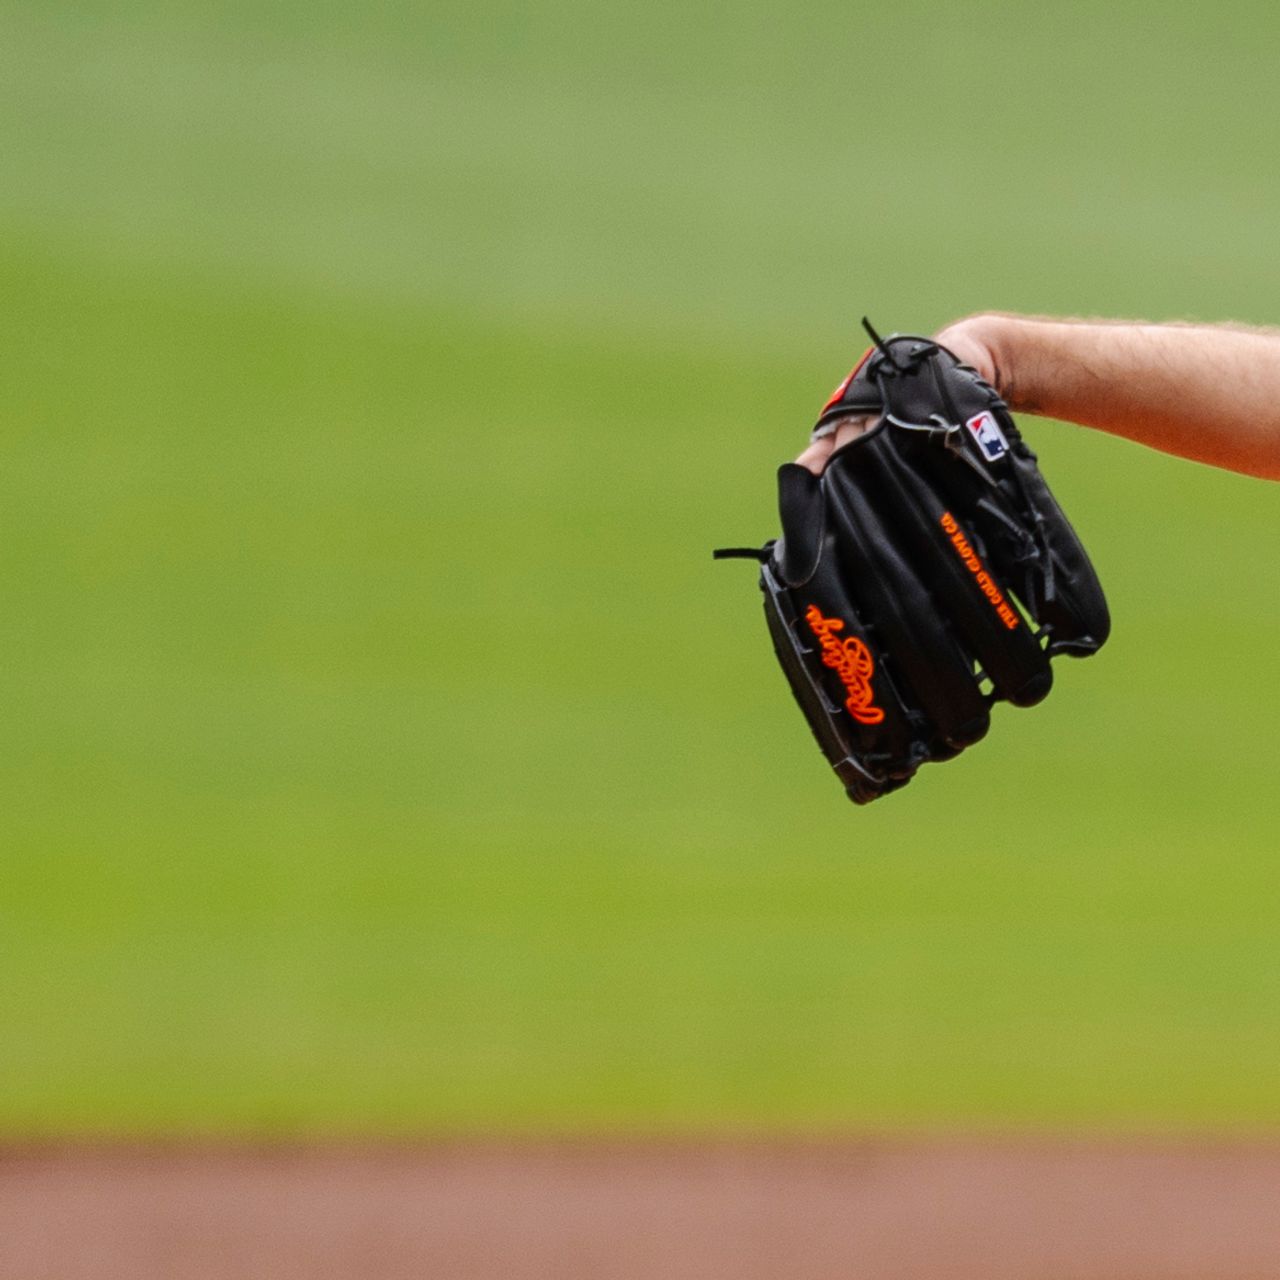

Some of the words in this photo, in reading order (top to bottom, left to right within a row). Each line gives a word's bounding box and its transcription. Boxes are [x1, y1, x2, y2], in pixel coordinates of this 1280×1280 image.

[951, 531, 981, 572] GLOVE
[976, 570, 1003, 605] GOLD
[997, 601, 1019, 629] THE
[805, 604, 884, 724] Rawlings
